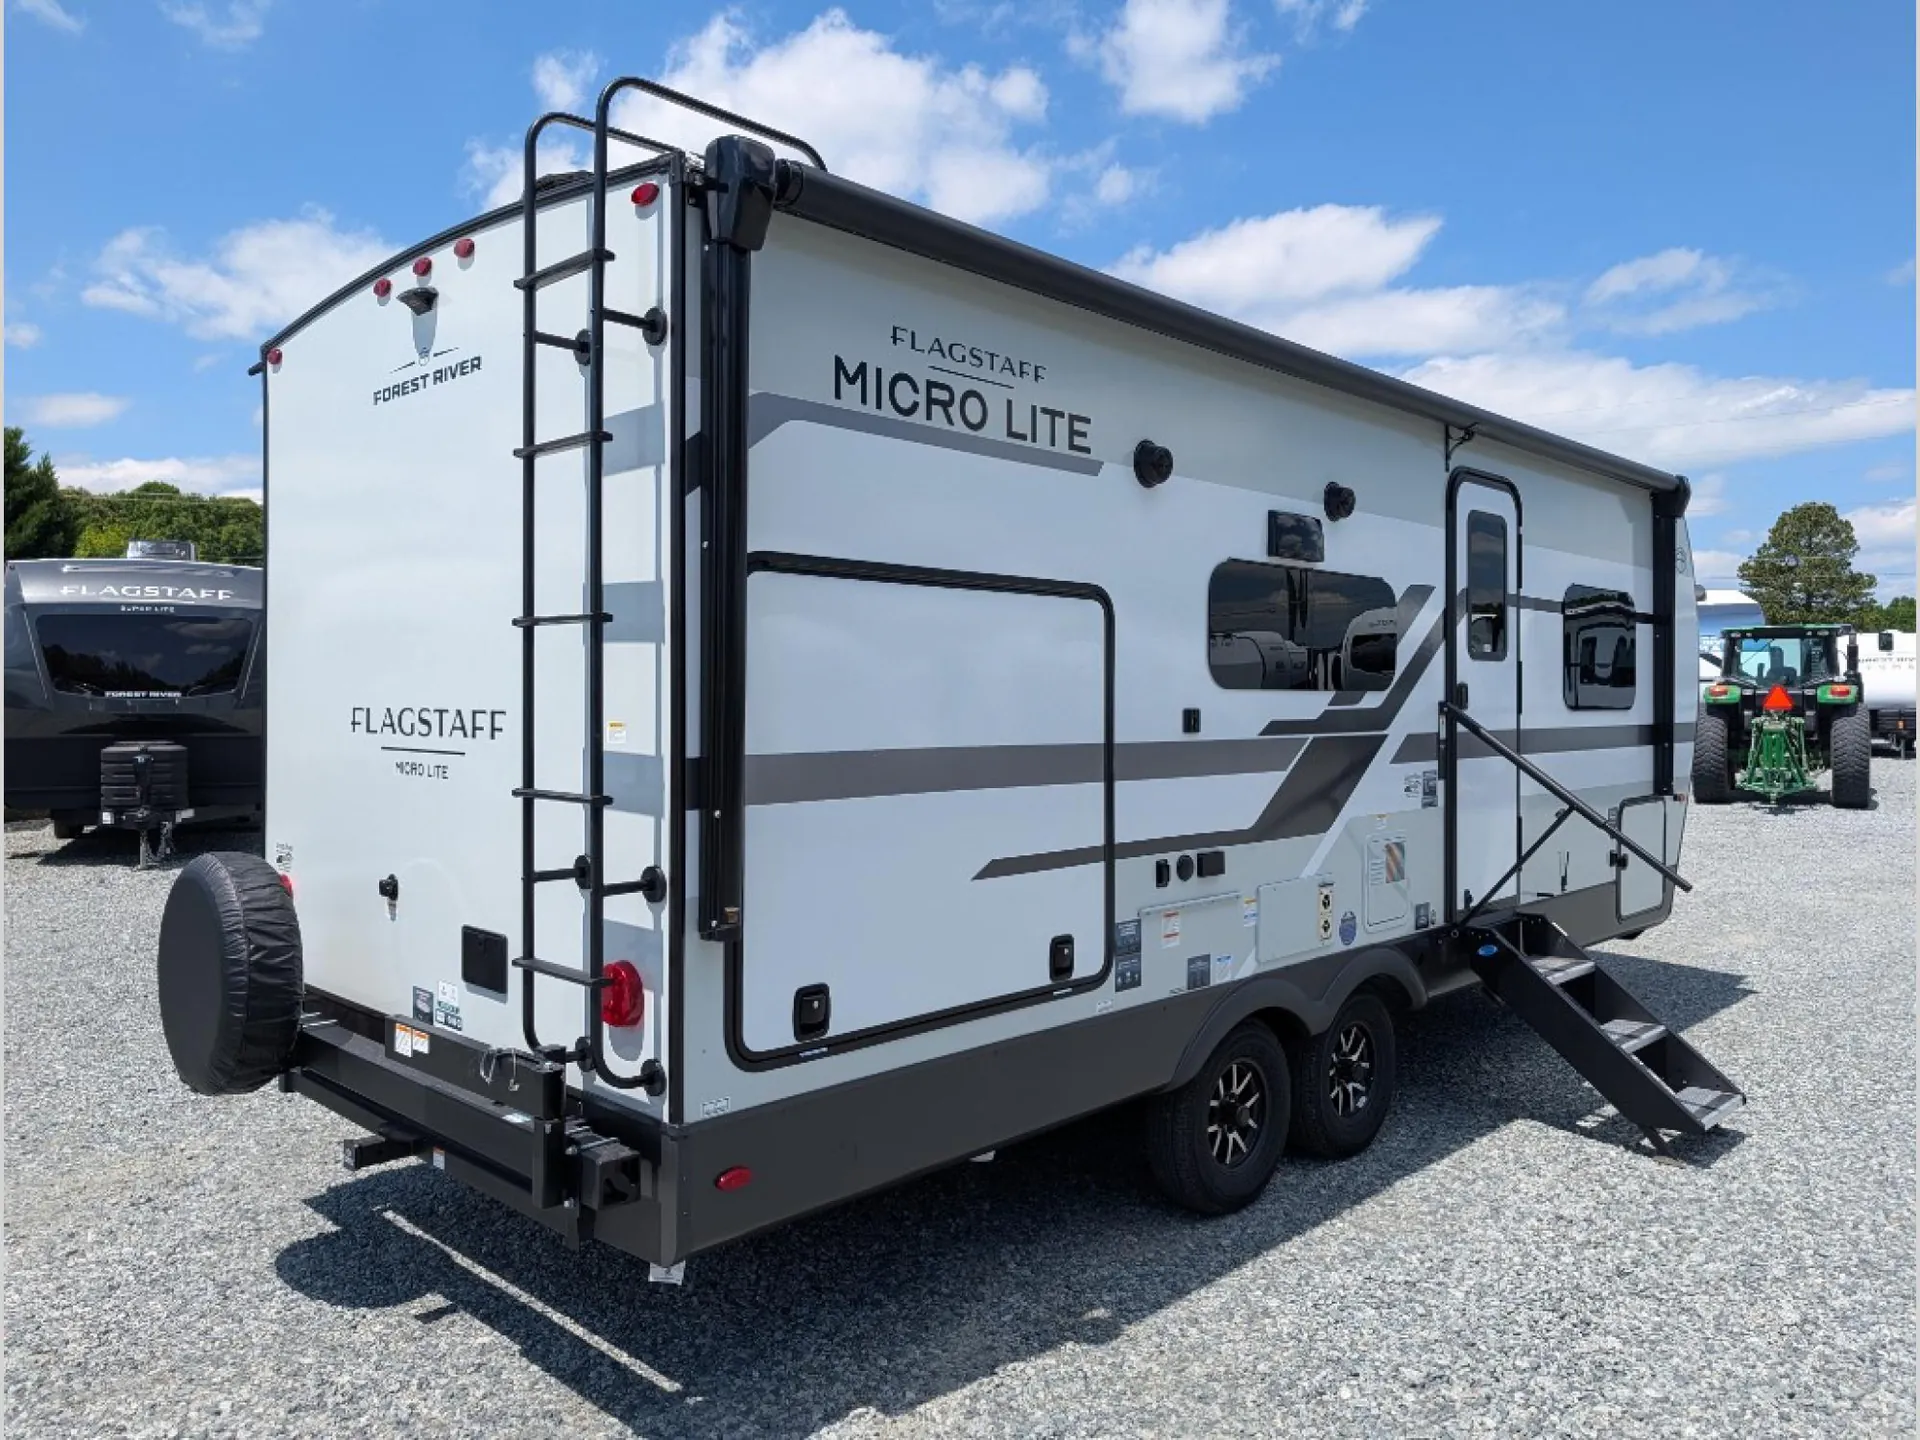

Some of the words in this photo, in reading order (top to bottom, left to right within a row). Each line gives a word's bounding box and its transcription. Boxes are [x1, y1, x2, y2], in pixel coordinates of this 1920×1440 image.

[890, 325, 1048, 383] FLAGSTAFF
[372, 373, 430, 406] FOREST
[433, 356, 483, 386] RIVER
[834, 354, 989, 432] MICRO
[1006, 398, 1092, 455] LITE
[60, 585, 235, 600] FLAGSTAFF
[103, 690, 148, 698] FOREST
[149, 690, 182, 698] RIVER
[350, 706, 507, 740] FLAGSTAFF
[395, 761, 425, 777] MICRO
[427, 764, 449, 780] LITE
